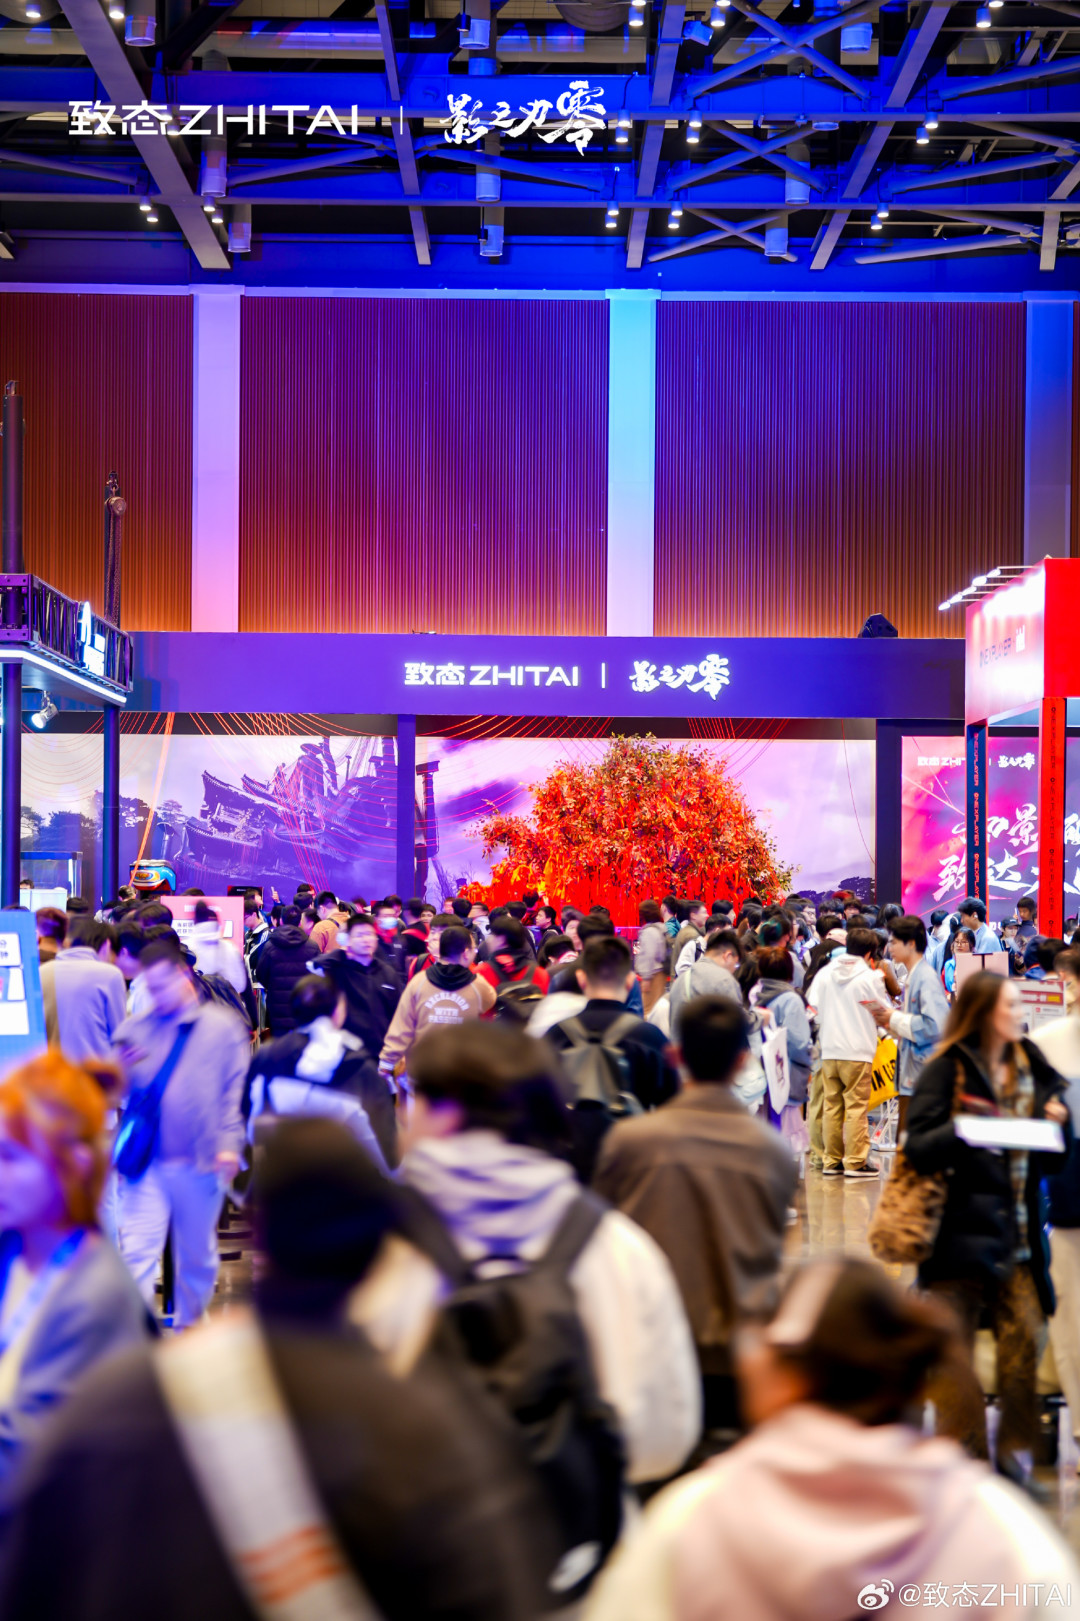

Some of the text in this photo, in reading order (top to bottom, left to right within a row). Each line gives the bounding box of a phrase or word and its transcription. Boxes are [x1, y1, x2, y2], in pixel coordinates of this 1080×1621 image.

[629, 653, 730, 701] 影之刃零
[434, 1007, 459, 1016] WITH
